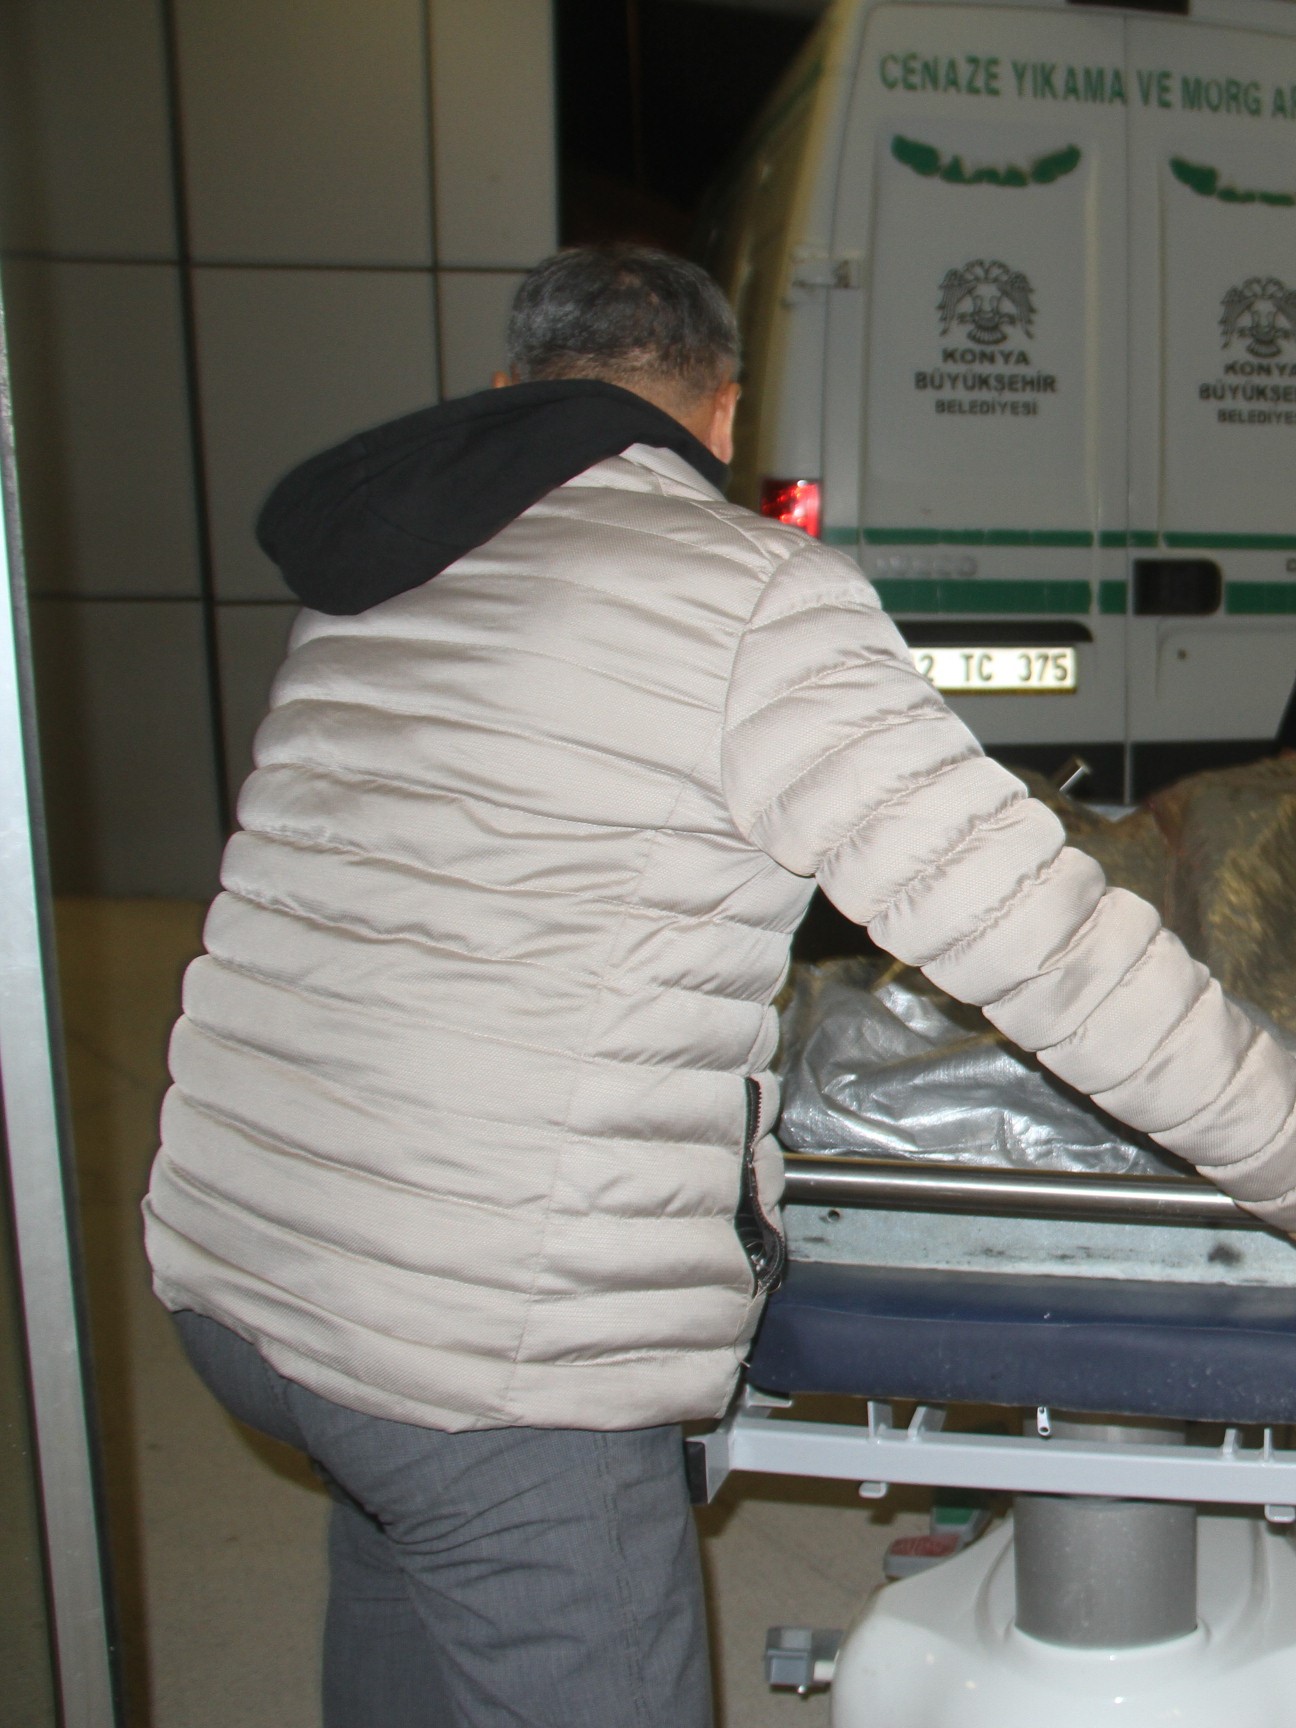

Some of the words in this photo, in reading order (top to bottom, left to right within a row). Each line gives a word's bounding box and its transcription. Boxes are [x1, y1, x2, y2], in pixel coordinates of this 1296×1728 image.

[879, 52, 1001, 97] CENAZE
[1010, 58, 1126, 106] YIKAMA
[1136, 69, 1173, 109] VE
[1180, 74, 1262, 117] MORG
[941, 347, 1031, 366] KONYA
[914, 367, 1057, 396] BÜYÜKŞEHİR
[960, 653, 993, 683] TC
[1018, 653, 1068, 683] 375
